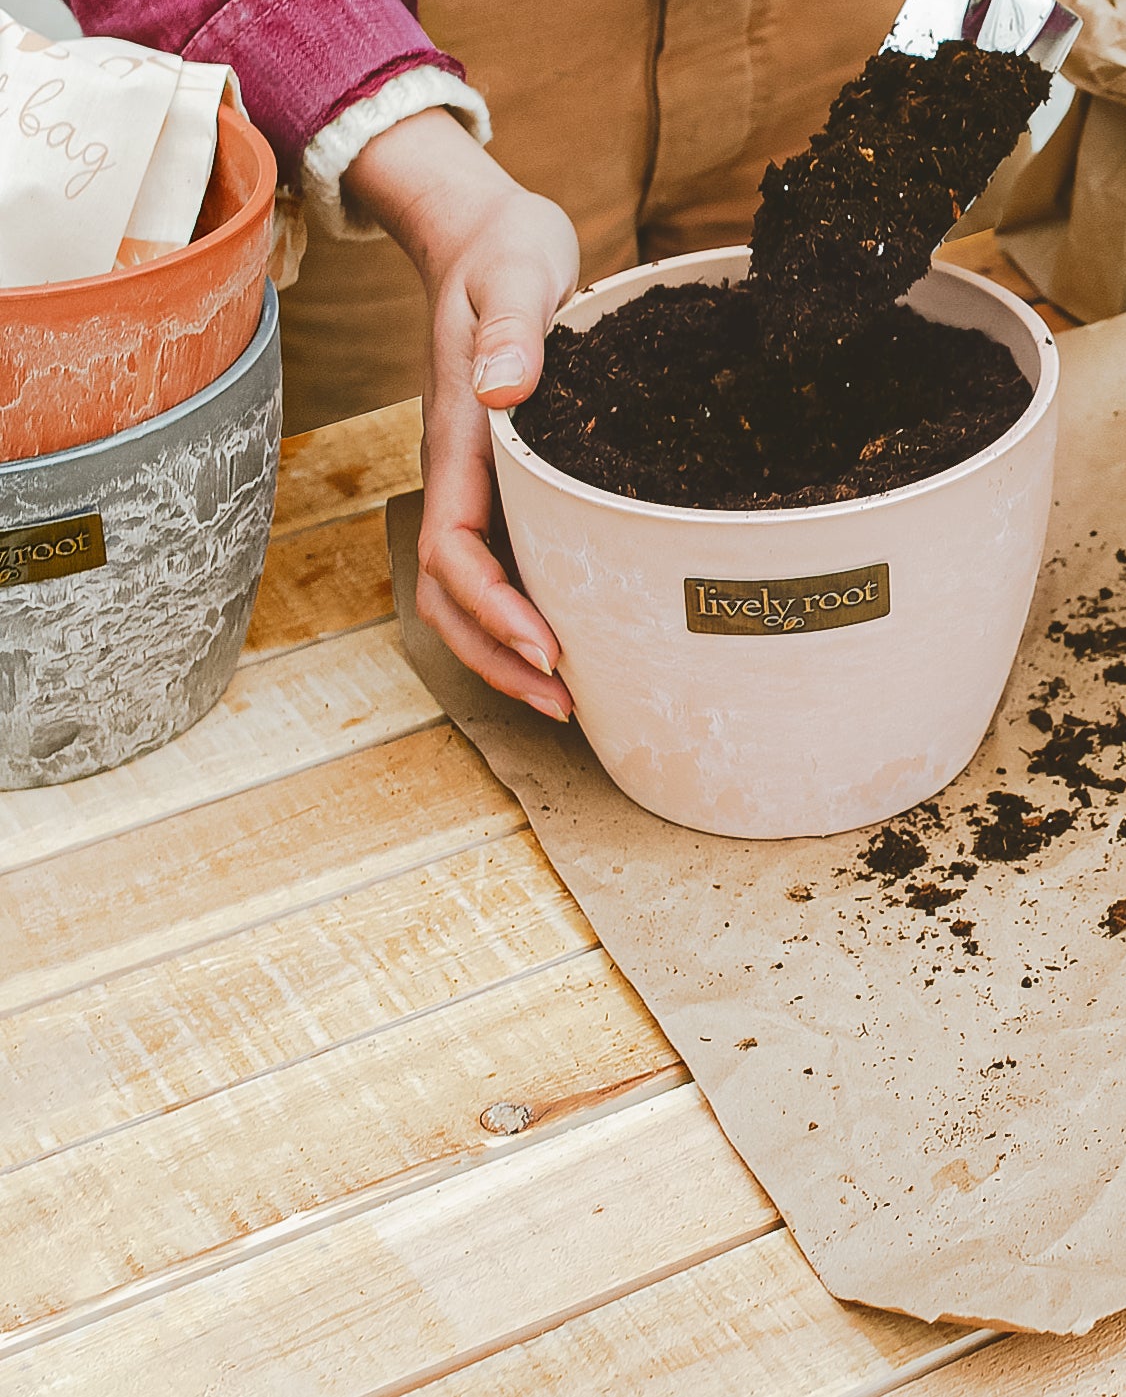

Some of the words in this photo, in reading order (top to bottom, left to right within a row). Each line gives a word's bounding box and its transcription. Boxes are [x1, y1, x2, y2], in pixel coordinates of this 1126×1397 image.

[18, 78, 117, 200] bag
[13, 531, 90, 565] root
[695, 586, 796, 627] lively
[802, 580, 879, 614] root
